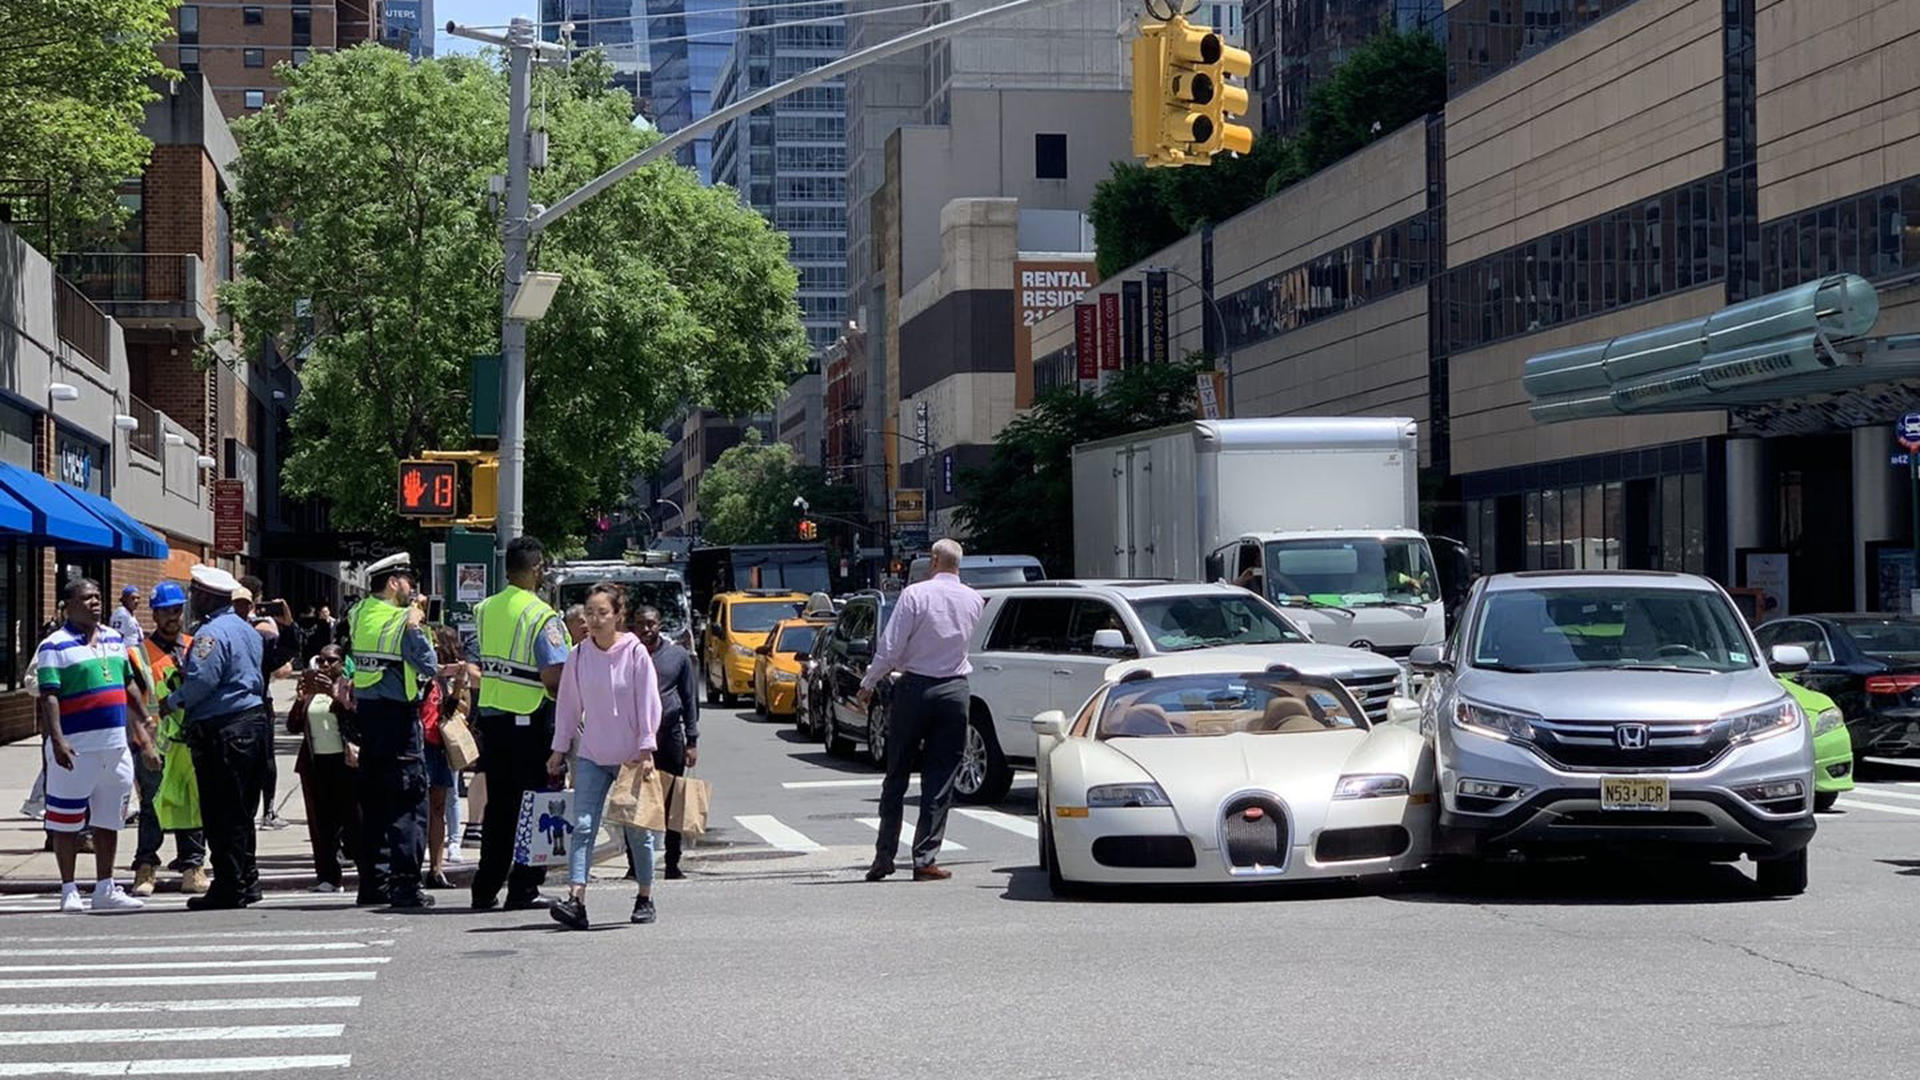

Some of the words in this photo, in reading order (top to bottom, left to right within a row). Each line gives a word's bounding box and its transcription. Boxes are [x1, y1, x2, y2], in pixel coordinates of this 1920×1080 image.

[1022, 271, 1092, 287] RENTAL
[434, 474, 452, 507] 13
[1606, 785, 1631, 802] N53
[1640, 785, 1664, 802] JCR
